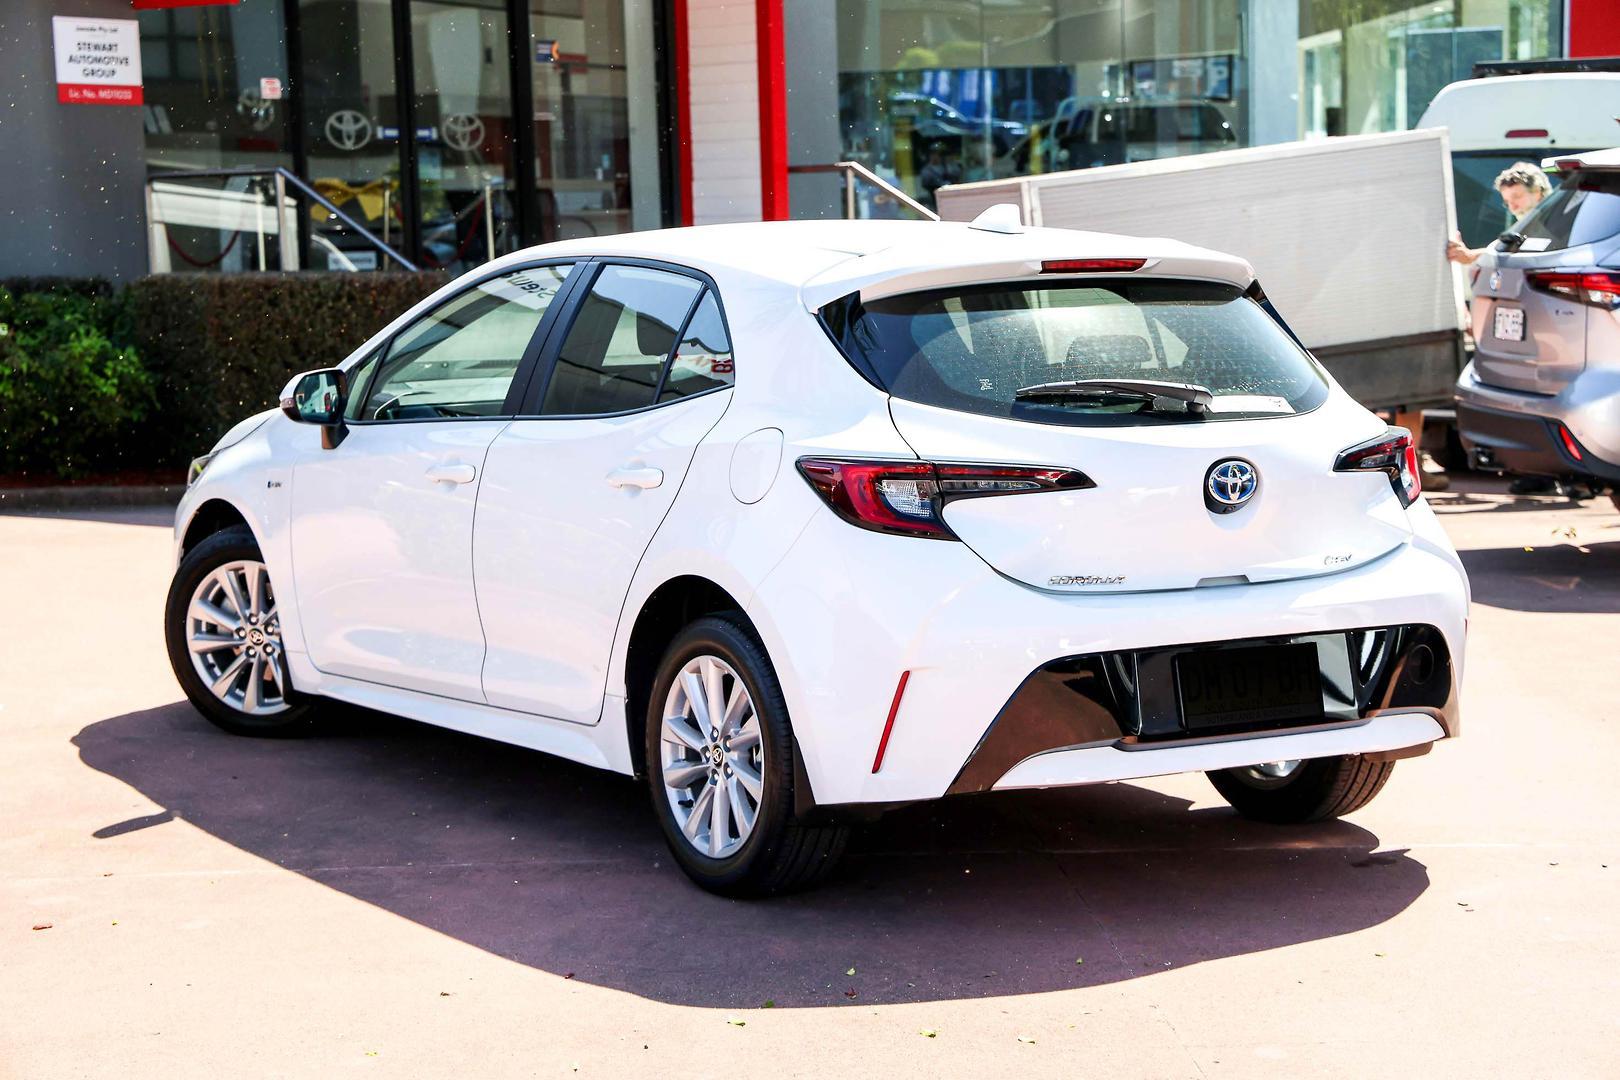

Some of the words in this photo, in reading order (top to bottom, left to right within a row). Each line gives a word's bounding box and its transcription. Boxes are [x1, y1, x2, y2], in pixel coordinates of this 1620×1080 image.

[76, 42, 119, 52] STEWART
[68, 54, 129, 66] AUTOMOTIVE
[82, 68, 117, 78] GROUP
